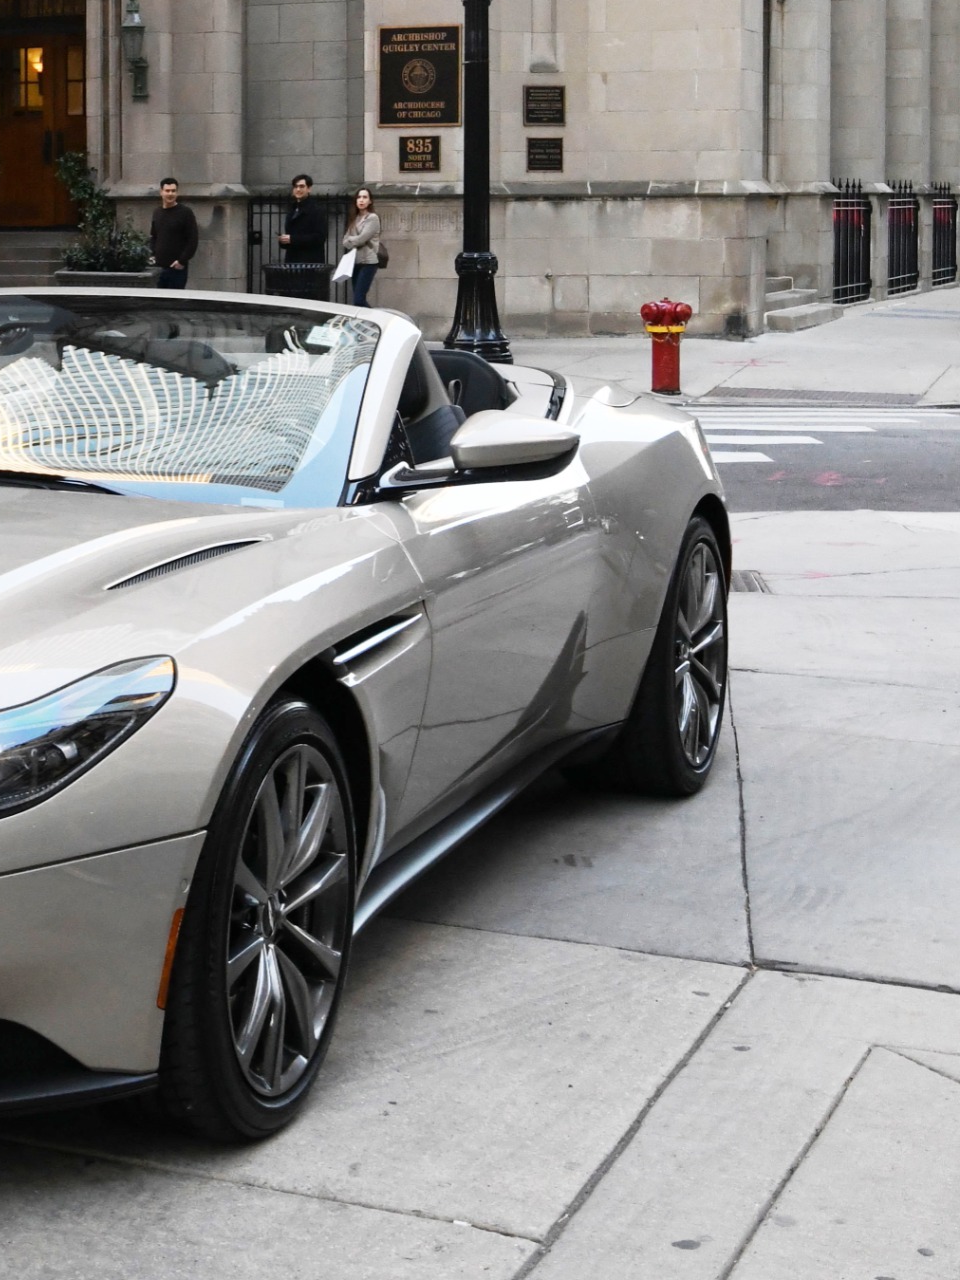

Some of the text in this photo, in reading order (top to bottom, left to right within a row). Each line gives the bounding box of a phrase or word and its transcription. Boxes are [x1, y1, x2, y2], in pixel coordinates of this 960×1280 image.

[391, 32, 447, 42] ARCHBISHOP
[382, 42, 456, 54] QUIGLEY CENTER
[393, 101, 445, 109] ARCHDIOCESE
[408, 110, 442, 118] CHICAGO
[406, 138, 433, 153] 835
[404, 161, 423, 169] RUSH
